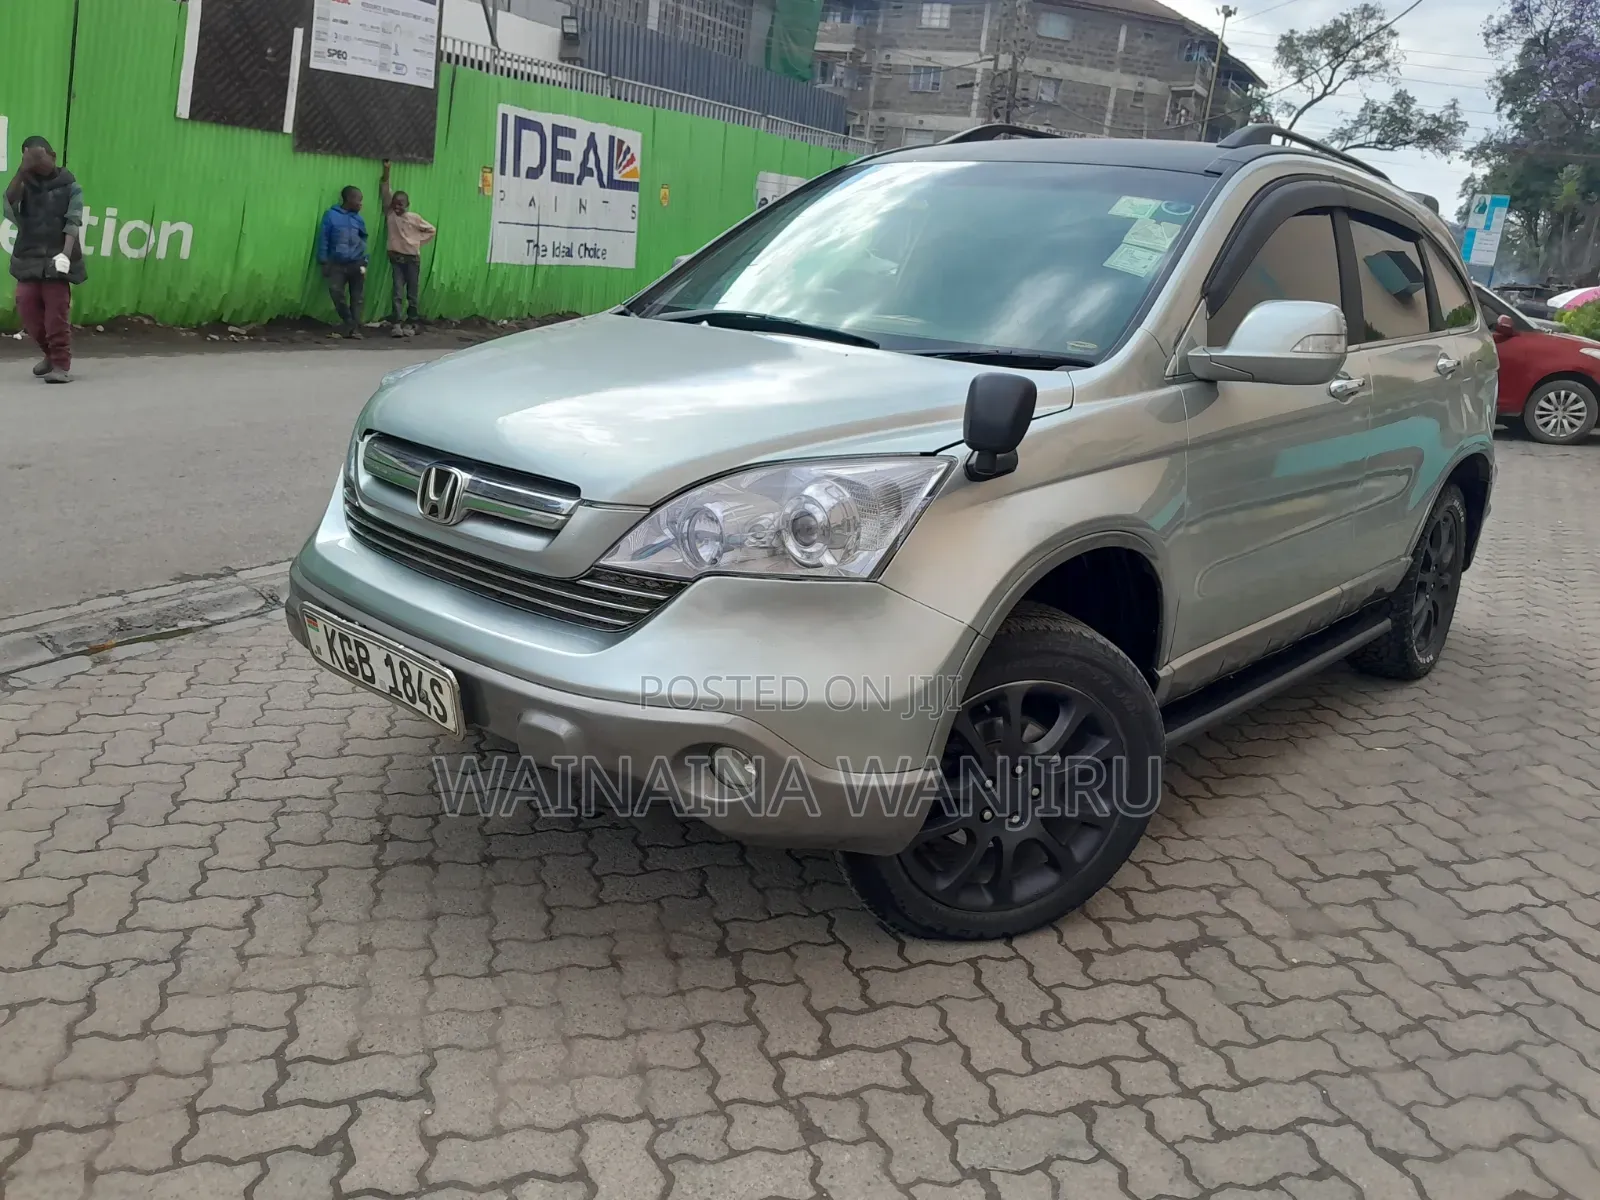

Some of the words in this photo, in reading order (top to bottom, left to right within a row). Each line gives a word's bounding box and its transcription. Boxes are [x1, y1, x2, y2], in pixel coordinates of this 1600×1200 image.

[499, 113, 640, 193] IDEAL
[526, 240, 547, 258] The
[552, 241, 574, 259] Ideal
[578, 242, 607, 260] Choice
[384, 653, 448, 724] 184S
